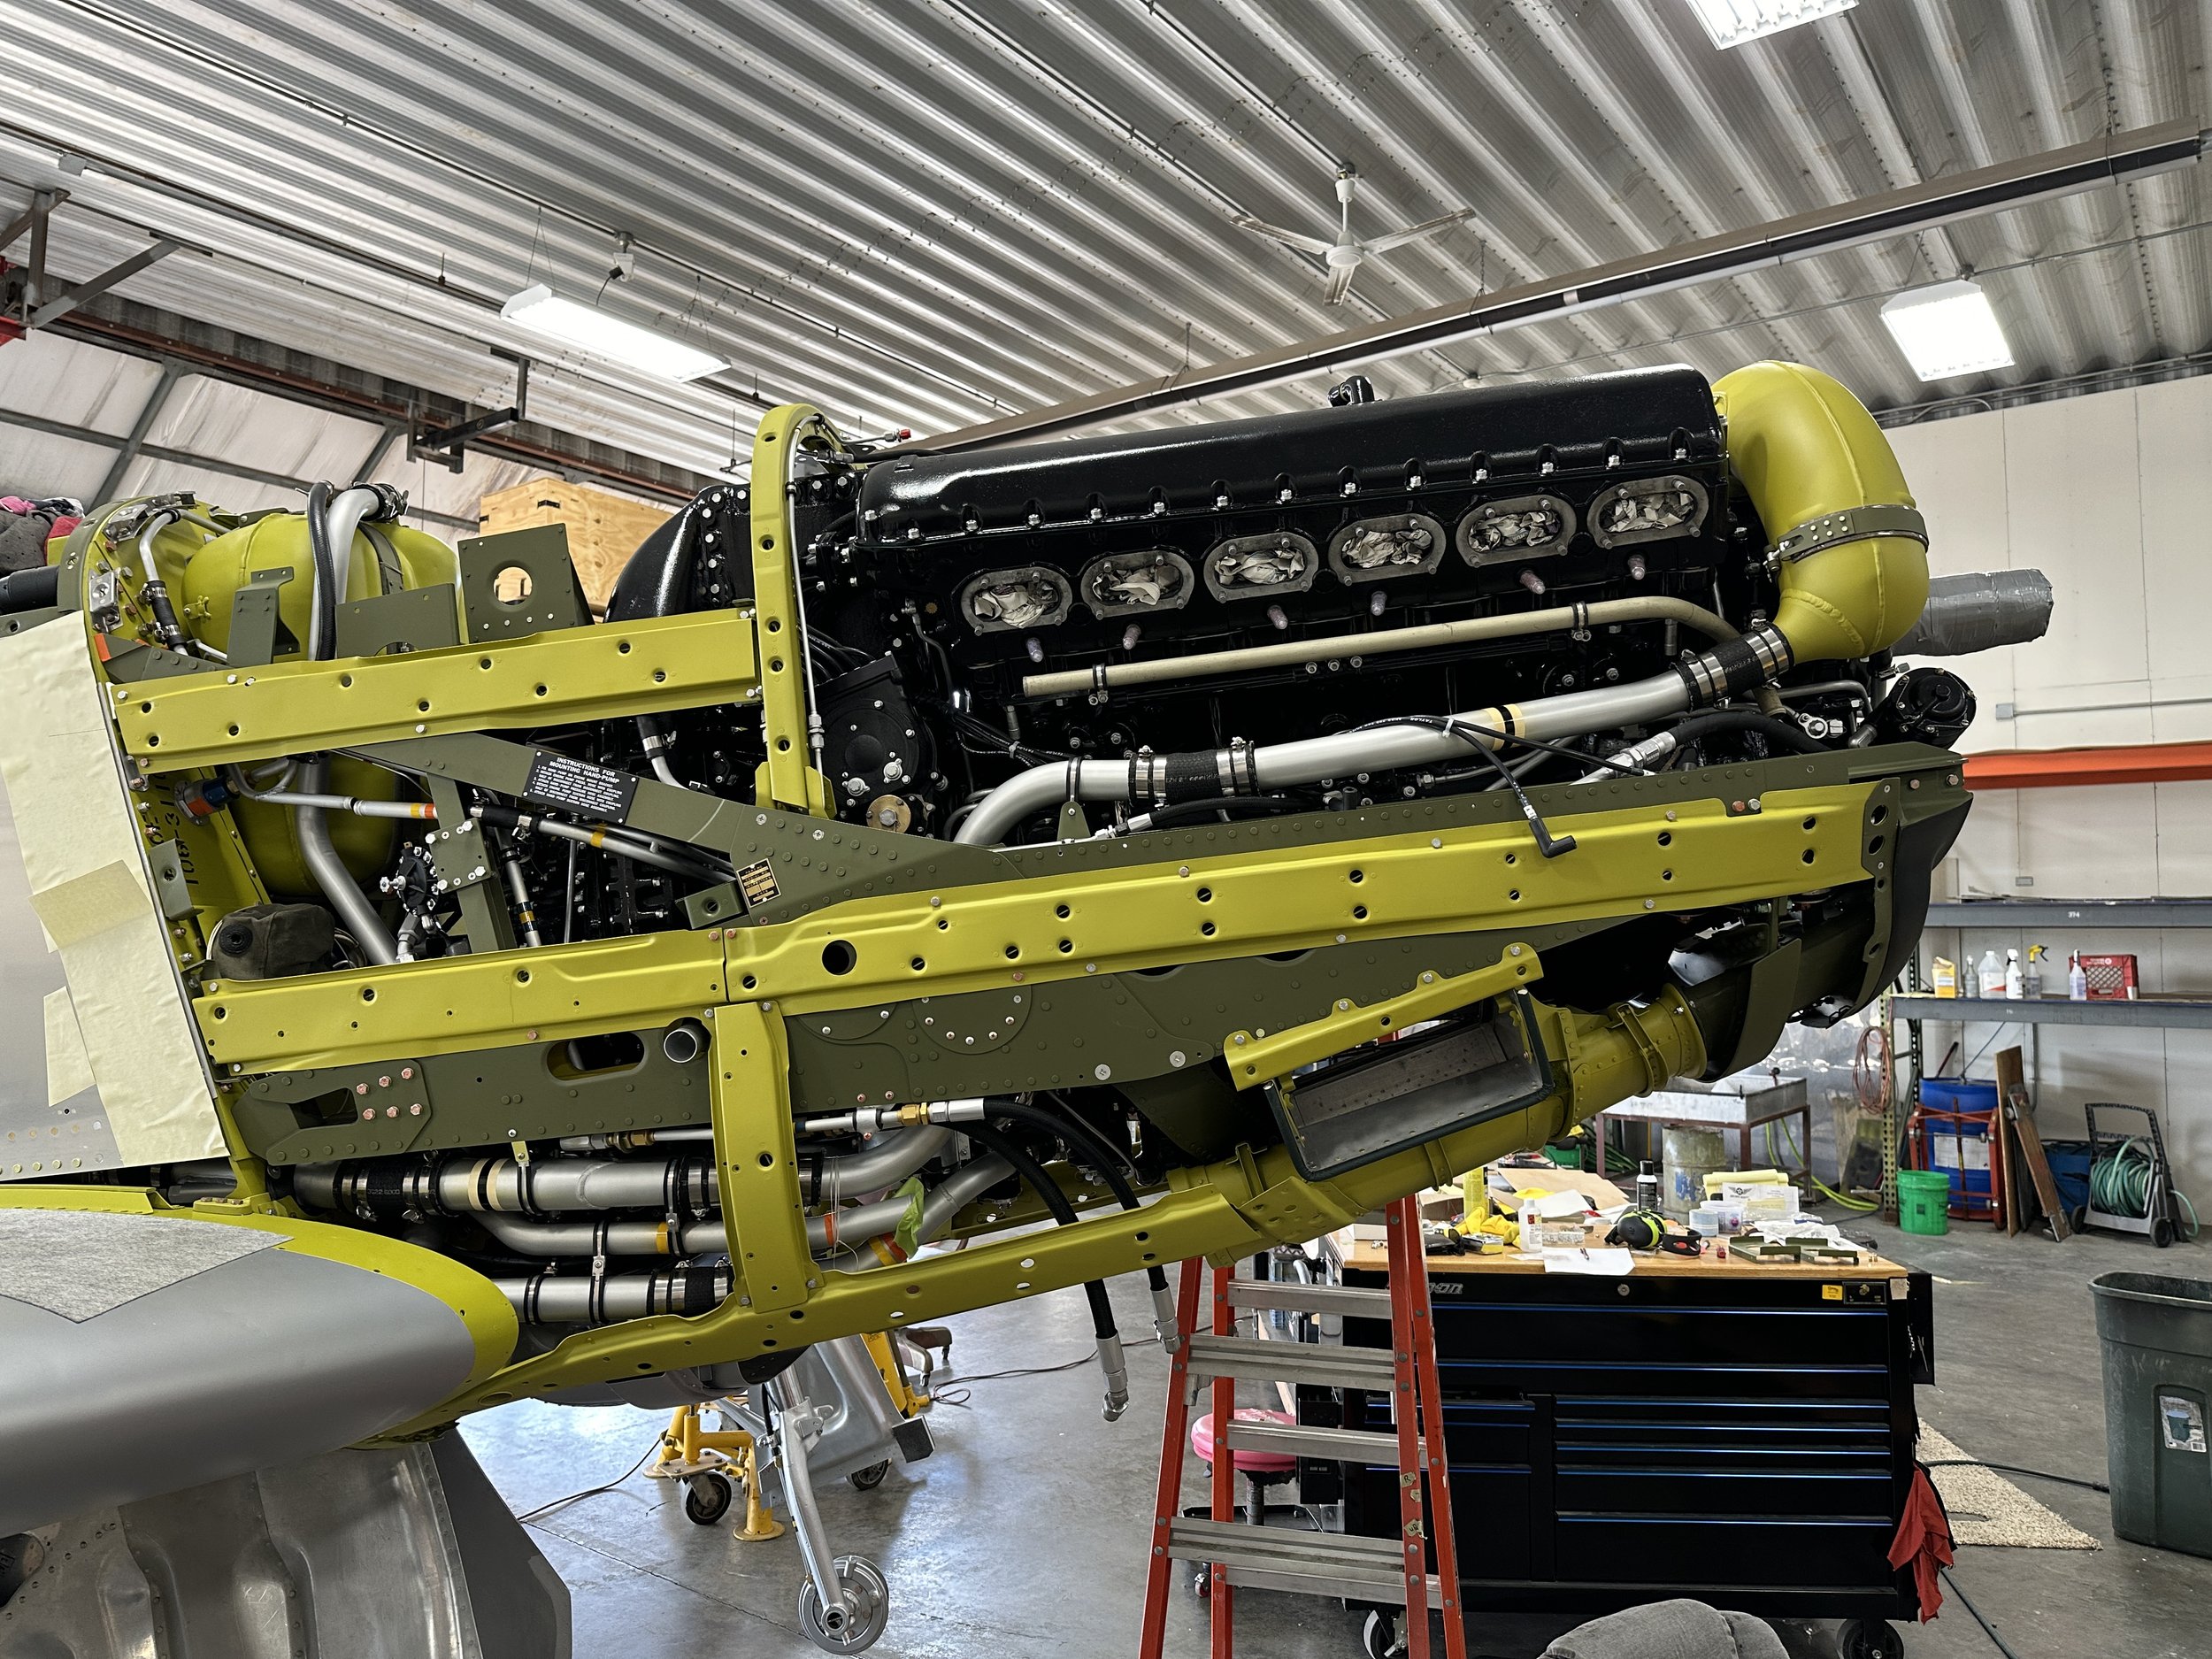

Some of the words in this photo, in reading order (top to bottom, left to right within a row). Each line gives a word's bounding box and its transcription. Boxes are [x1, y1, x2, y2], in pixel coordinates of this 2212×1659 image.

[549, 761, 580, 773] MOUNTING
[583, 770, 619, 783] HAND-PUMP
[557, 757, 600, 772] INSTRUCTIONS
